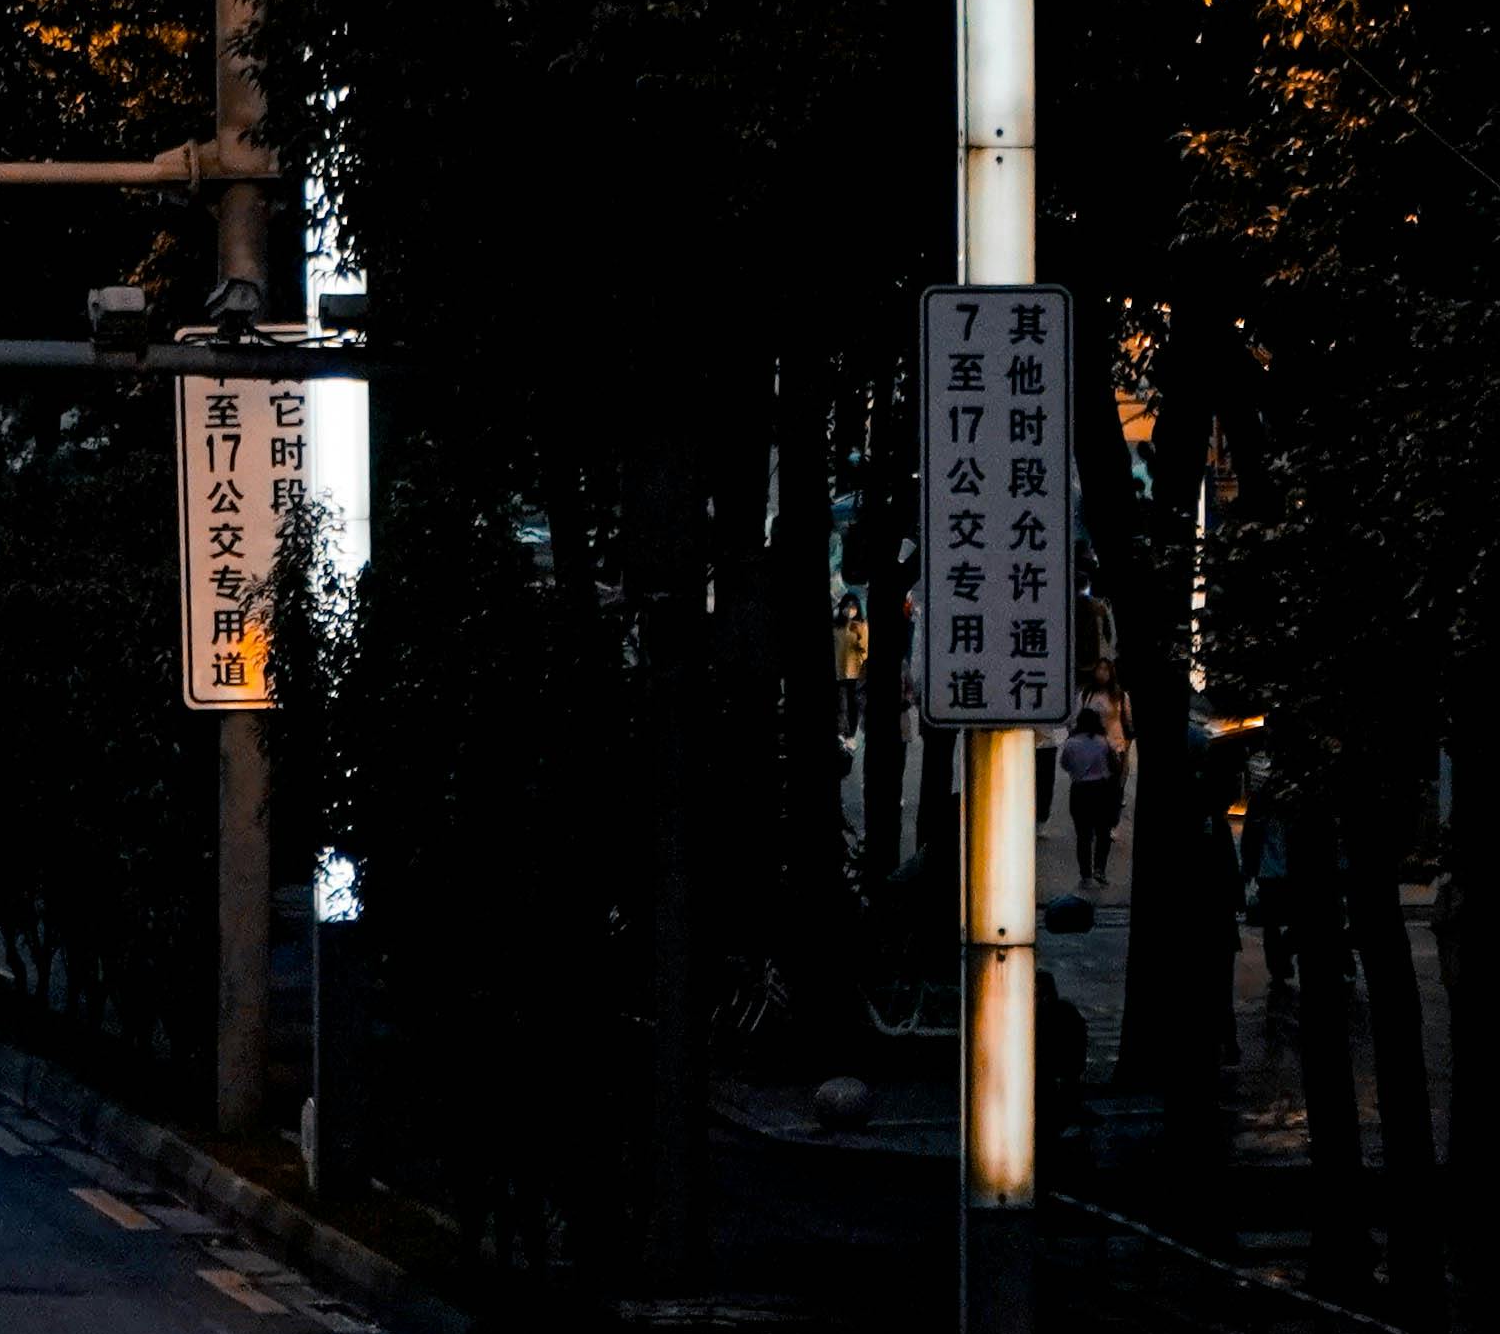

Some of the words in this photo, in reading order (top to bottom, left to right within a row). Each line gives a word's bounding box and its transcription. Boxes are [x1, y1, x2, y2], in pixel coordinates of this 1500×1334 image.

[204, 376, 248, 688] 至17公交专用道
[946, 304, 988, 711] 7至17公交专用道
[1006, 304, 1049, 711] 其他时段允许通行
